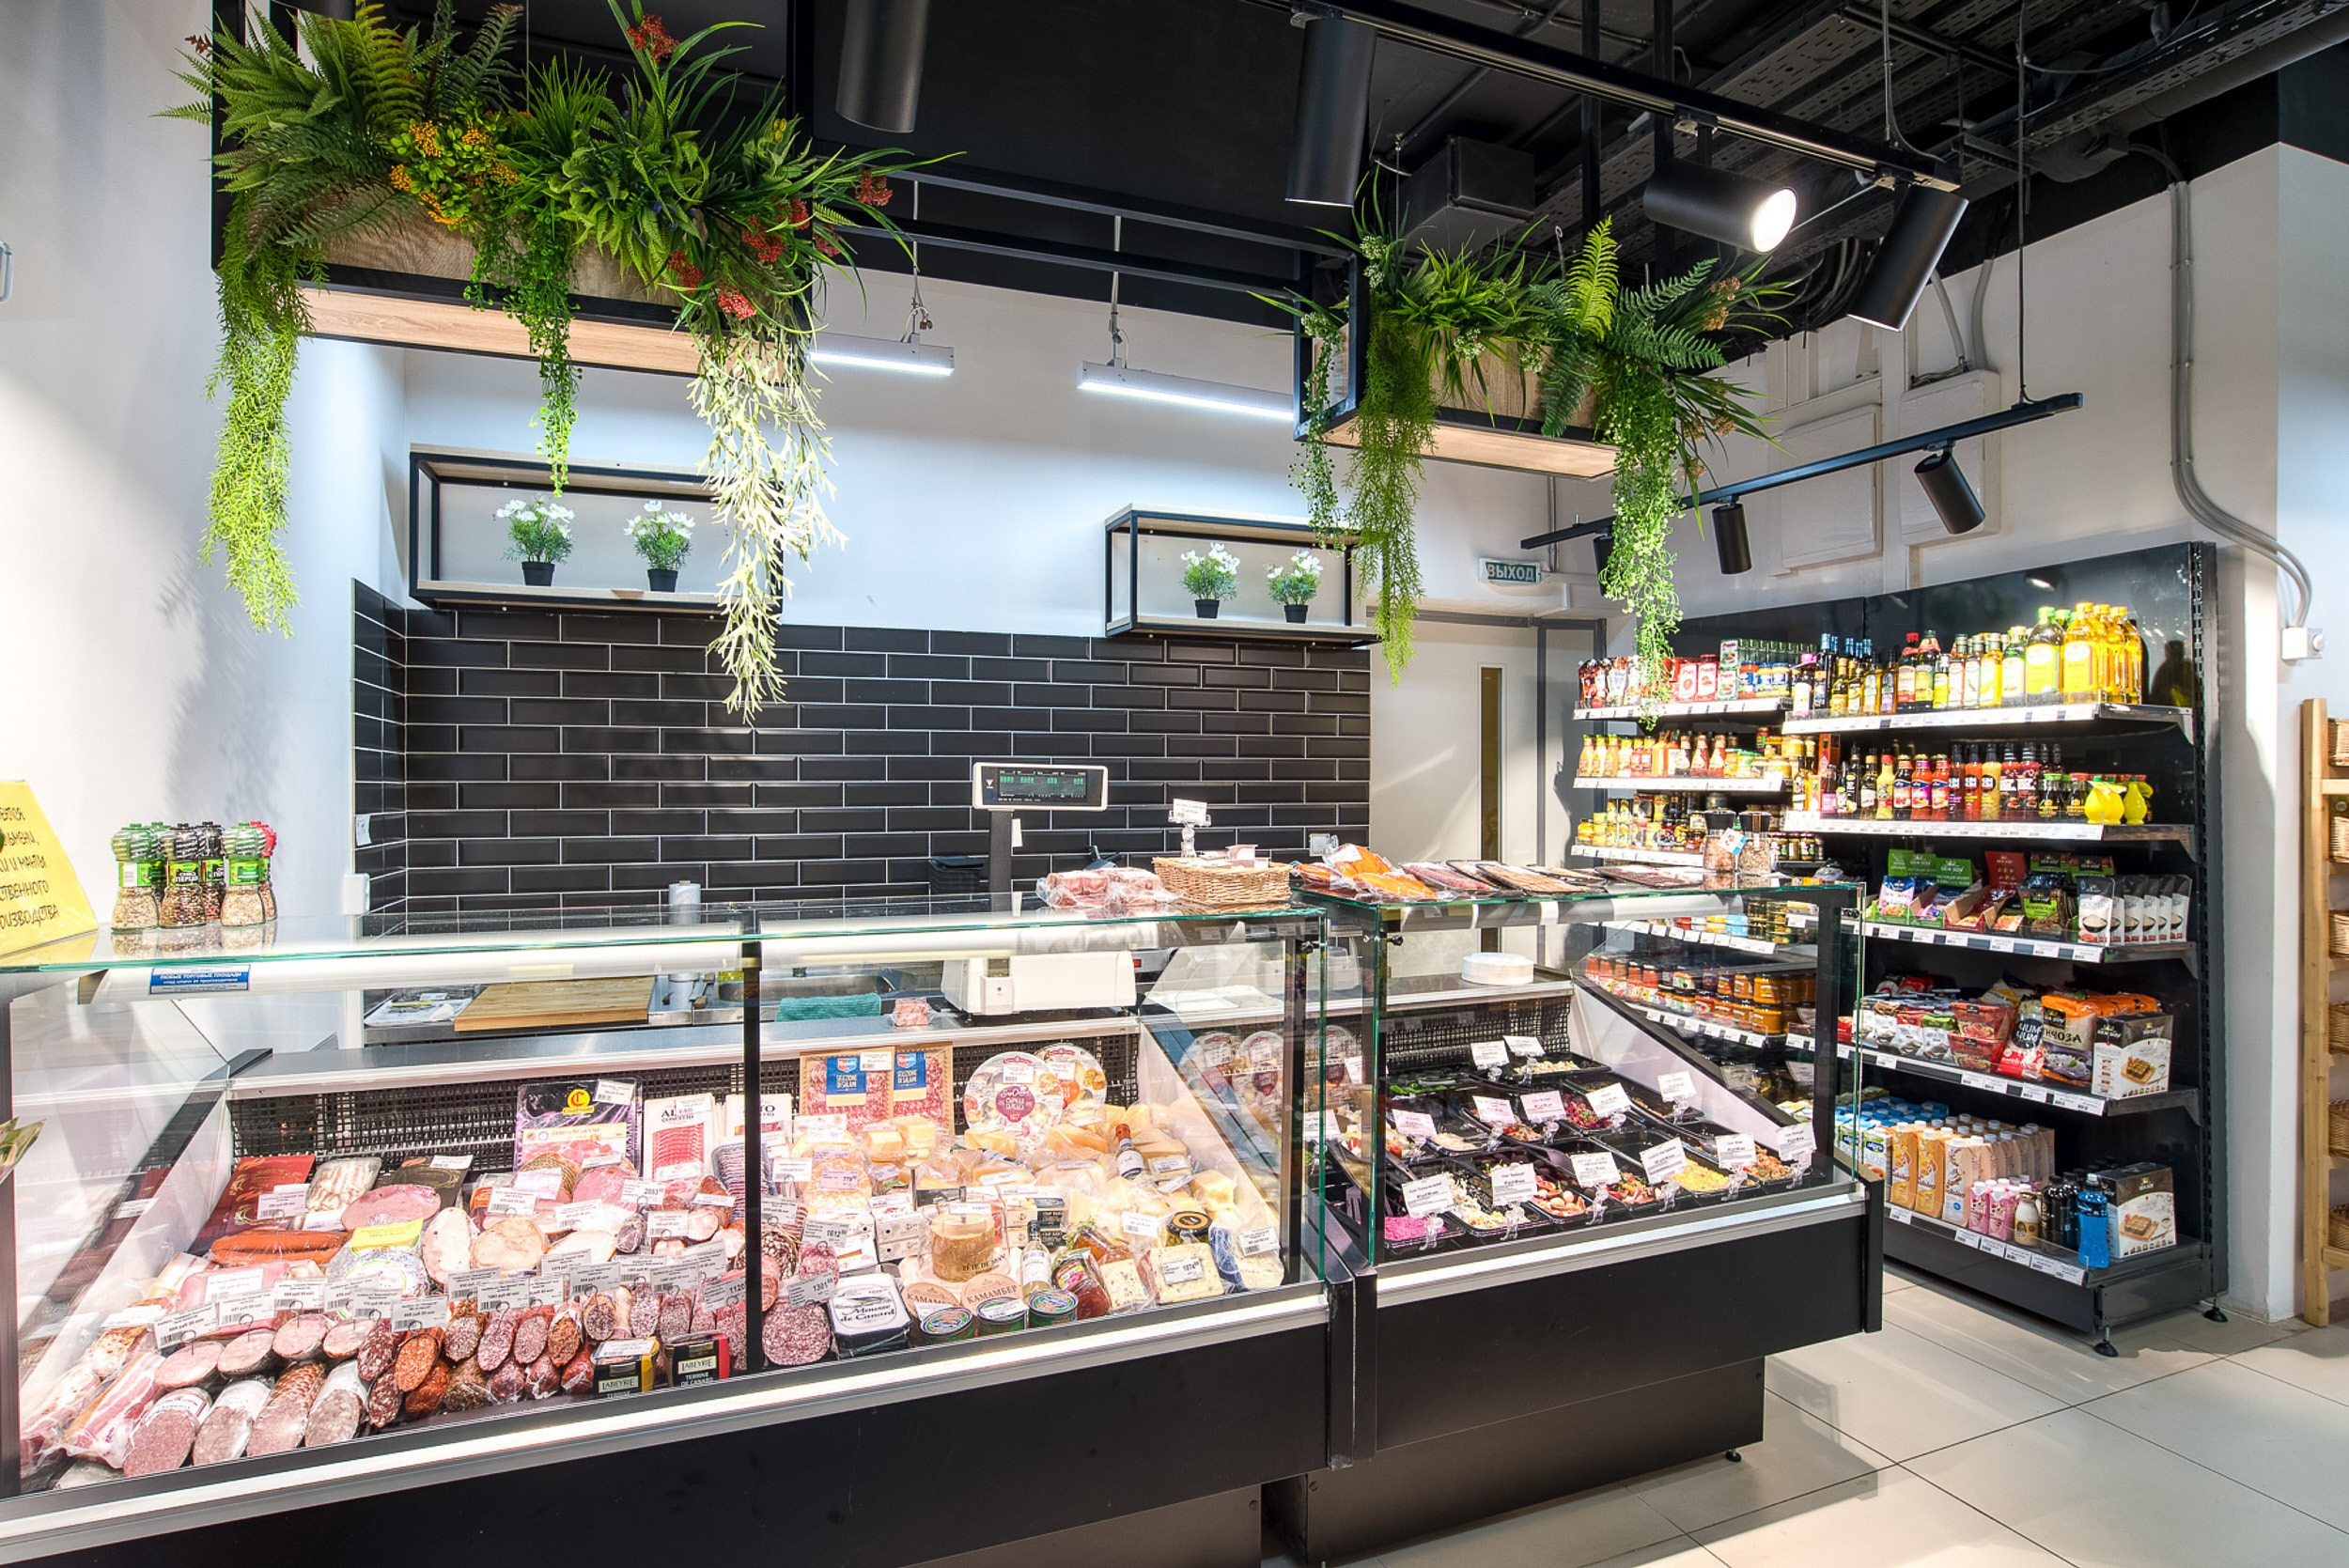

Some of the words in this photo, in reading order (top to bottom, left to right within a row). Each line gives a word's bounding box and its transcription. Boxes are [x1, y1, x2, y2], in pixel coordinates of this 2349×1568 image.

[1487, 564, 1534, 582] ВЫХОД
[2045, 1029, 2082, 1044] НЧОЗА
[967, 1284, 1018, 1305] КАМАМБЕР
[856, 1309, 895, 1321] Canard
[681, 1358, 713, 1372] LABEYRIE
[602, 1378, 635, 1390] LABEYRIE
